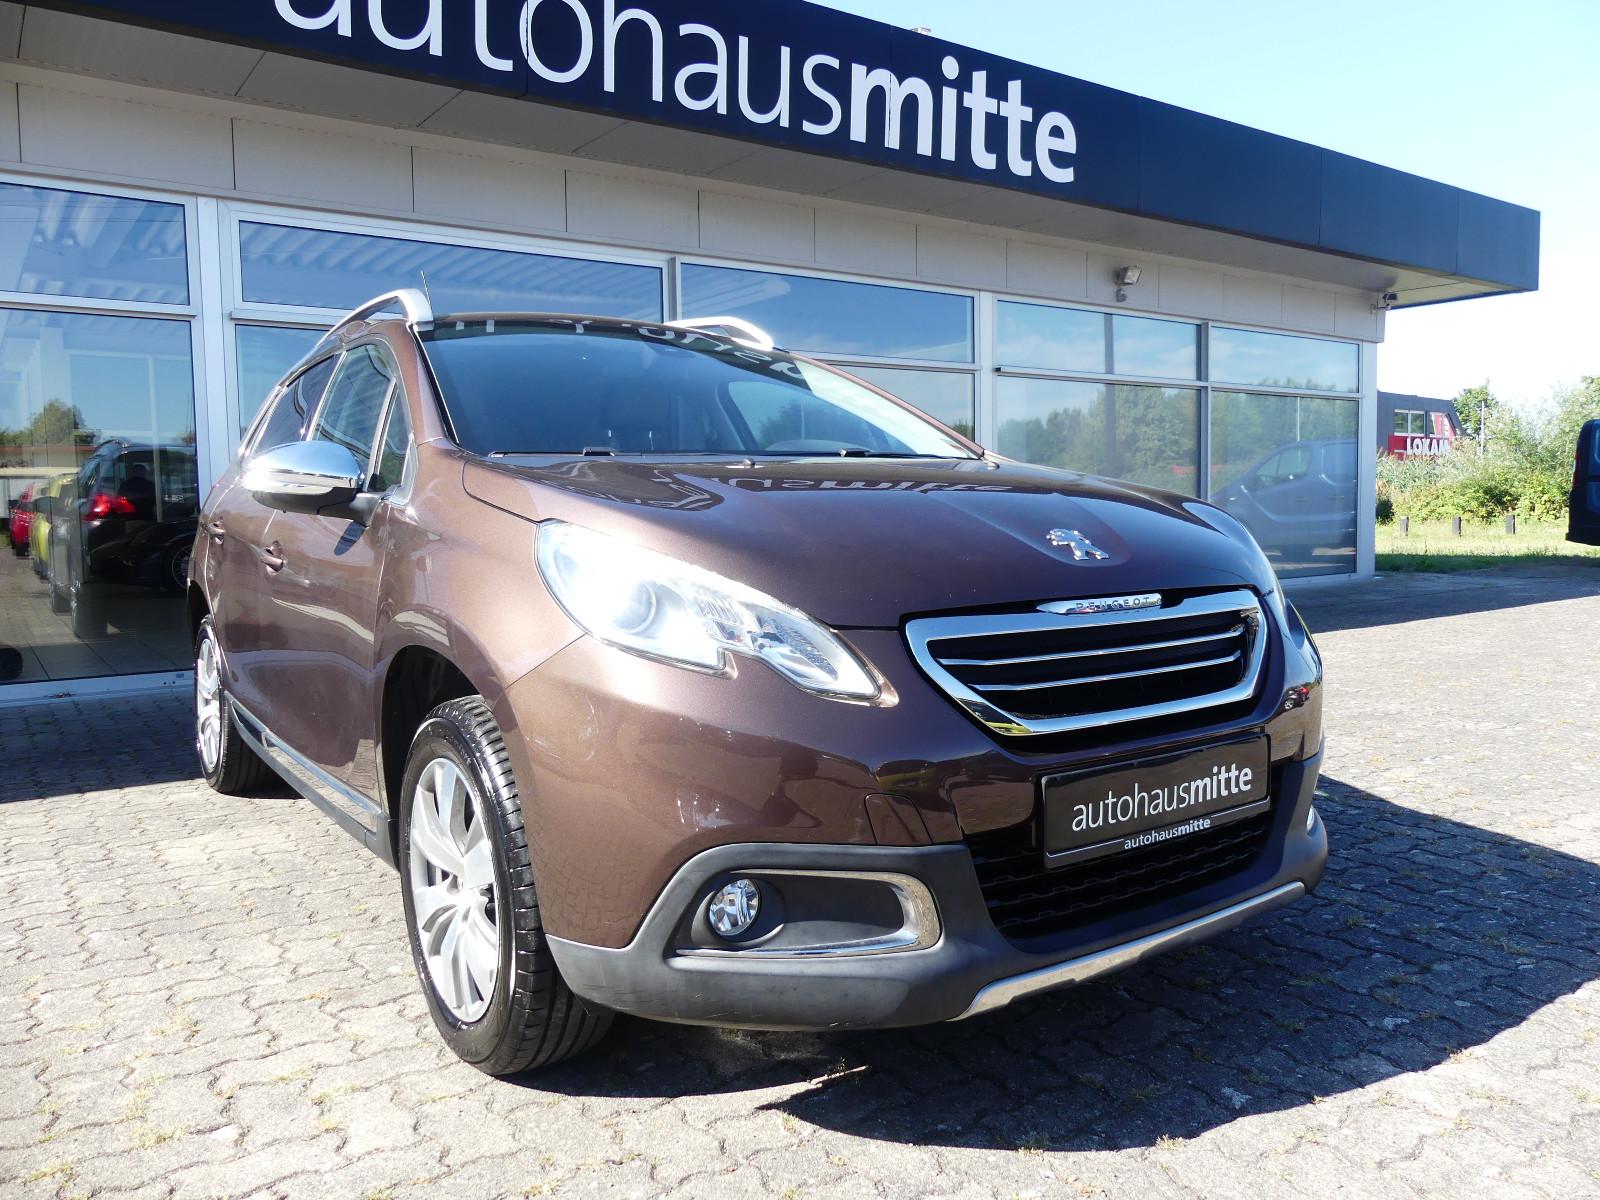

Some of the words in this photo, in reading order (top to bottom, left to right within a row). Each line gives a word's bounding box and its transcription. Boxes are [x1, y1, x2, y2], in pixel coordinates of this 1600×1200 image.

[1075, 597, 1150, 610] PEUGEOT
[1071, 762, 1253, 832] autohausmitte
[1124, 817, 1211, 850] autohausmitte
